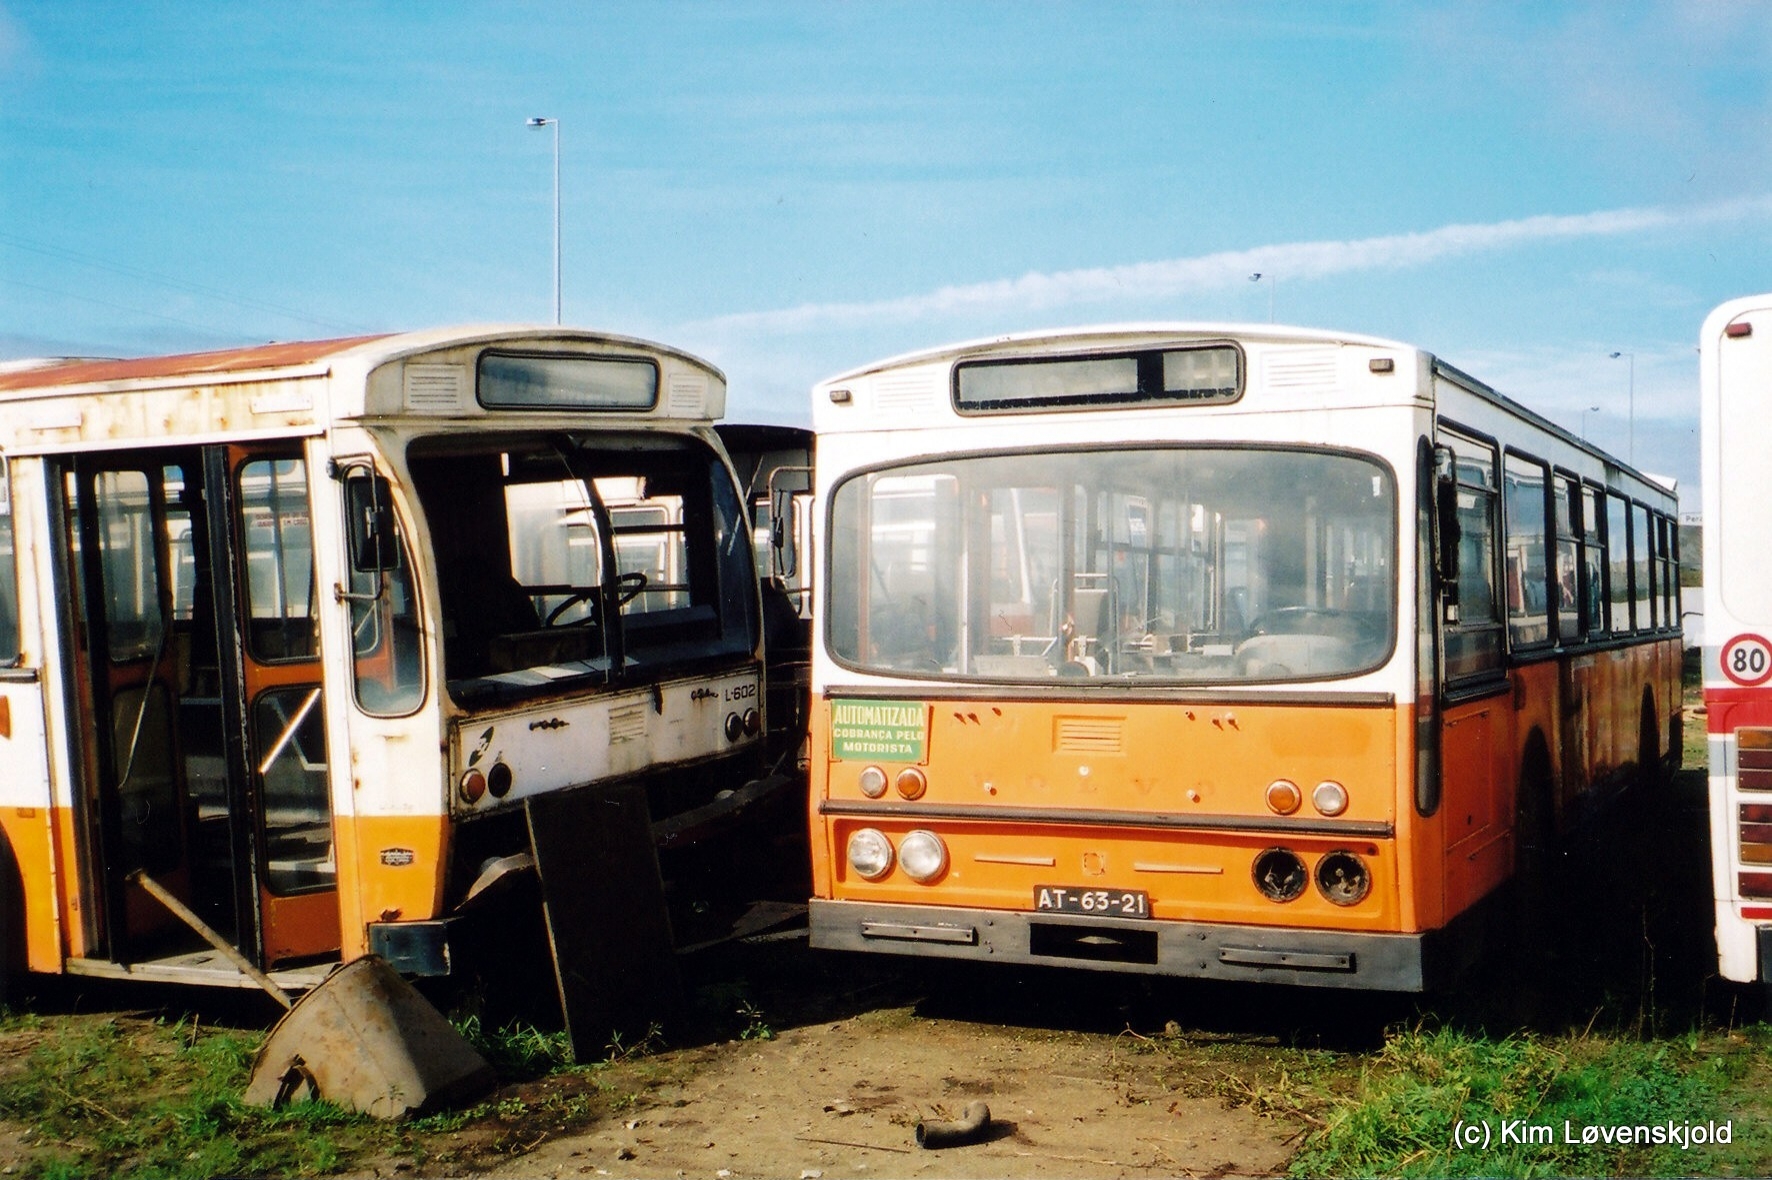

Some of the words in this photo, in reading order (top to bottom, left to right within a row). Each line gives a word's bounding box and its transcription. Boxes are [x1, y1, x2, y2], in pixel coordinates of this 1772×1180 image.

[1733, 648, 1765, 673] 80
[834, 704, 925, 727] AUTOMATIZADA
[833, 728, 893, 740] COBRANÇA
[896, 730, 925, 741] PELO
[842, 742, 913, 754] MOTORISTA
[1039, 888, 1144, 914] AT-63-21
